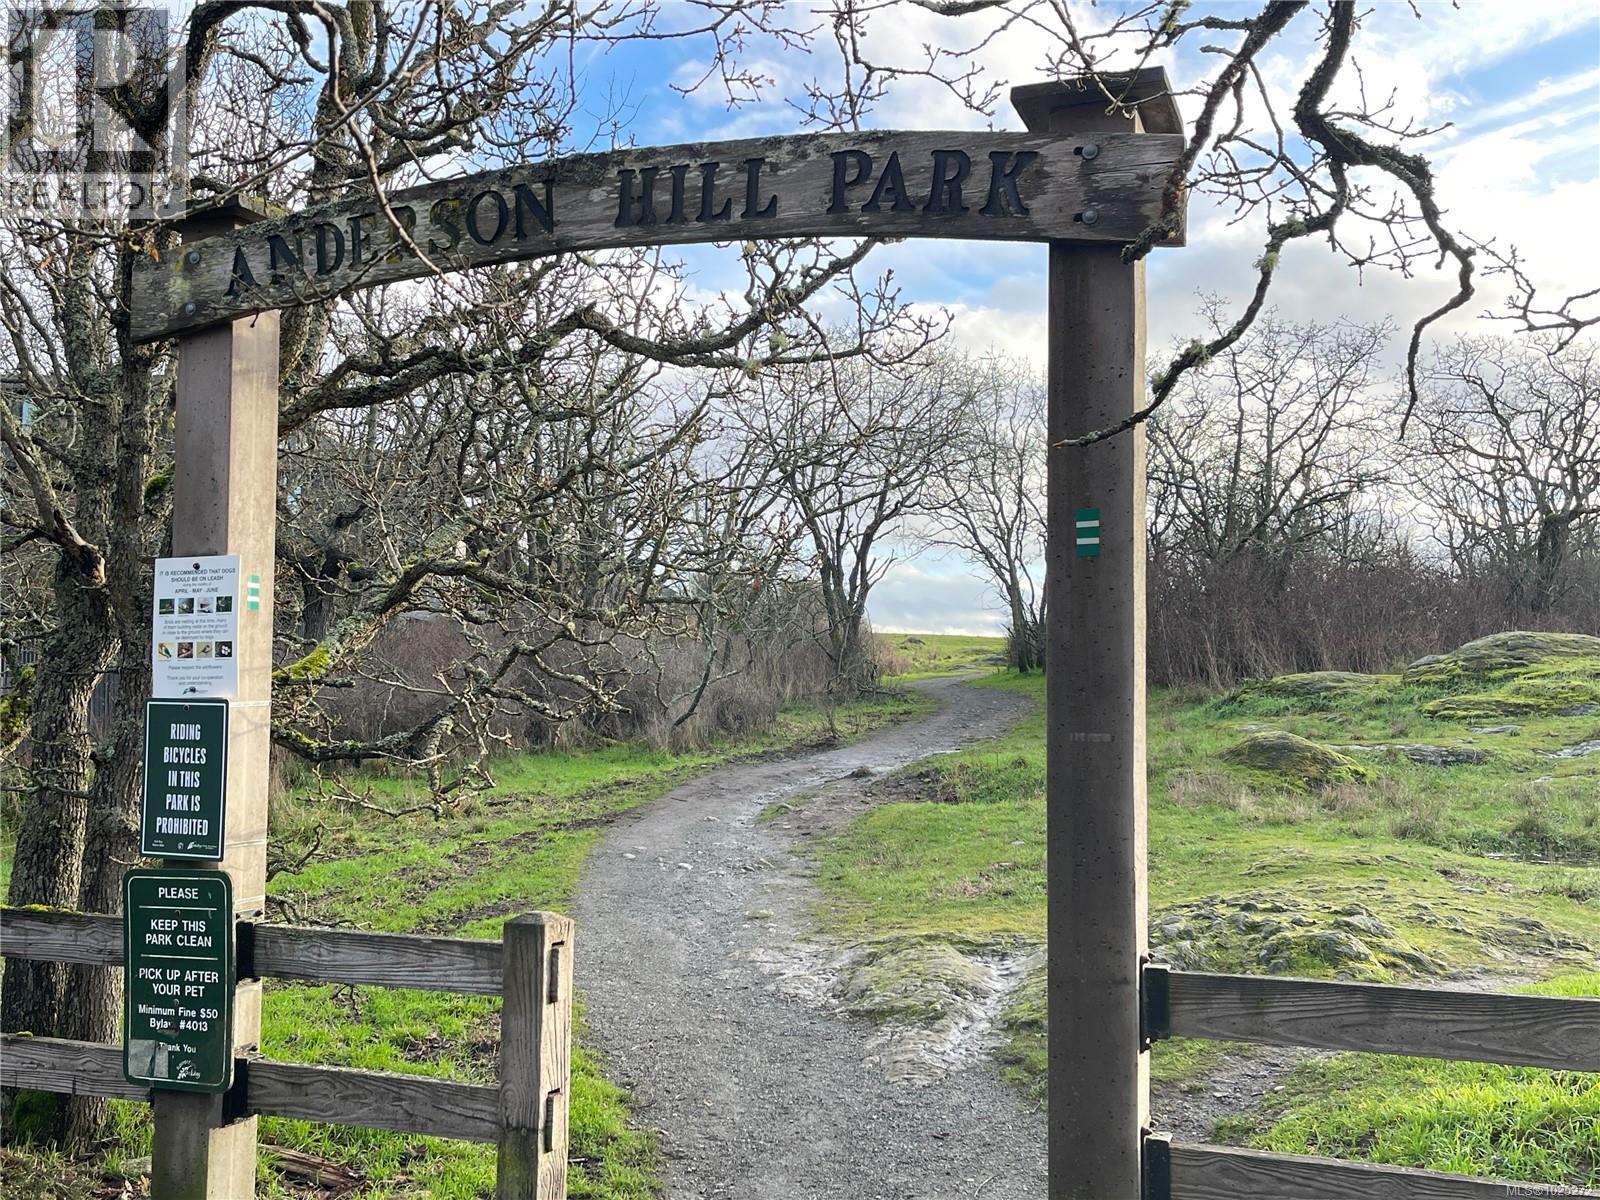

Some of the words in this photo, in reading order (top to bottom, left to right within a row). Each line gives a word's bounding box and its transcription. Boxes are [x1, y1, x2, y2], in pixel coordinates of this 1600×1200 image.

[223, 177, 556, 298] ANDERSON
[614, 158, 778, 228] HILL
[826, 149, 1039, 217] PARK
[170, 723, 201, 741] RIDING
[163, 746, 207, 765] BICYCLES
[168, 770, 178, 787] IN
[180, 770, 200, 788] THIS
[166, 794, 189, 811] PARK
[191, 795, 201, 812] IS
[156, 817, 209, 836] PROHIBITED
[158, 887, 199, 899] PLEASE
[150, 919, 178, 931] KEEP
[182, 920, 206, 932] THIS
[146, 934, 172, 945] PARK
[176, 935, 212, 947] CLEAN
[139, 968, 162, 980] PICK
[166, 969, 181, 981] UP
[184, 970, 219, 983] AFTER
[152, 983, 181, 996] YOUR
[184, 985, 205, 997] PET
[138, 1004, 175, 1016] Minimum
[178, 1007, 197, 1017] Fine
[200, 1008, 218, 1019] $50
[150, 1018, 173, 1030] Byla
[180, 1020, 208, 1032] #4013
[159, 1042, 180, 1052] Tank
[183, 1044, 197, 1053] You
